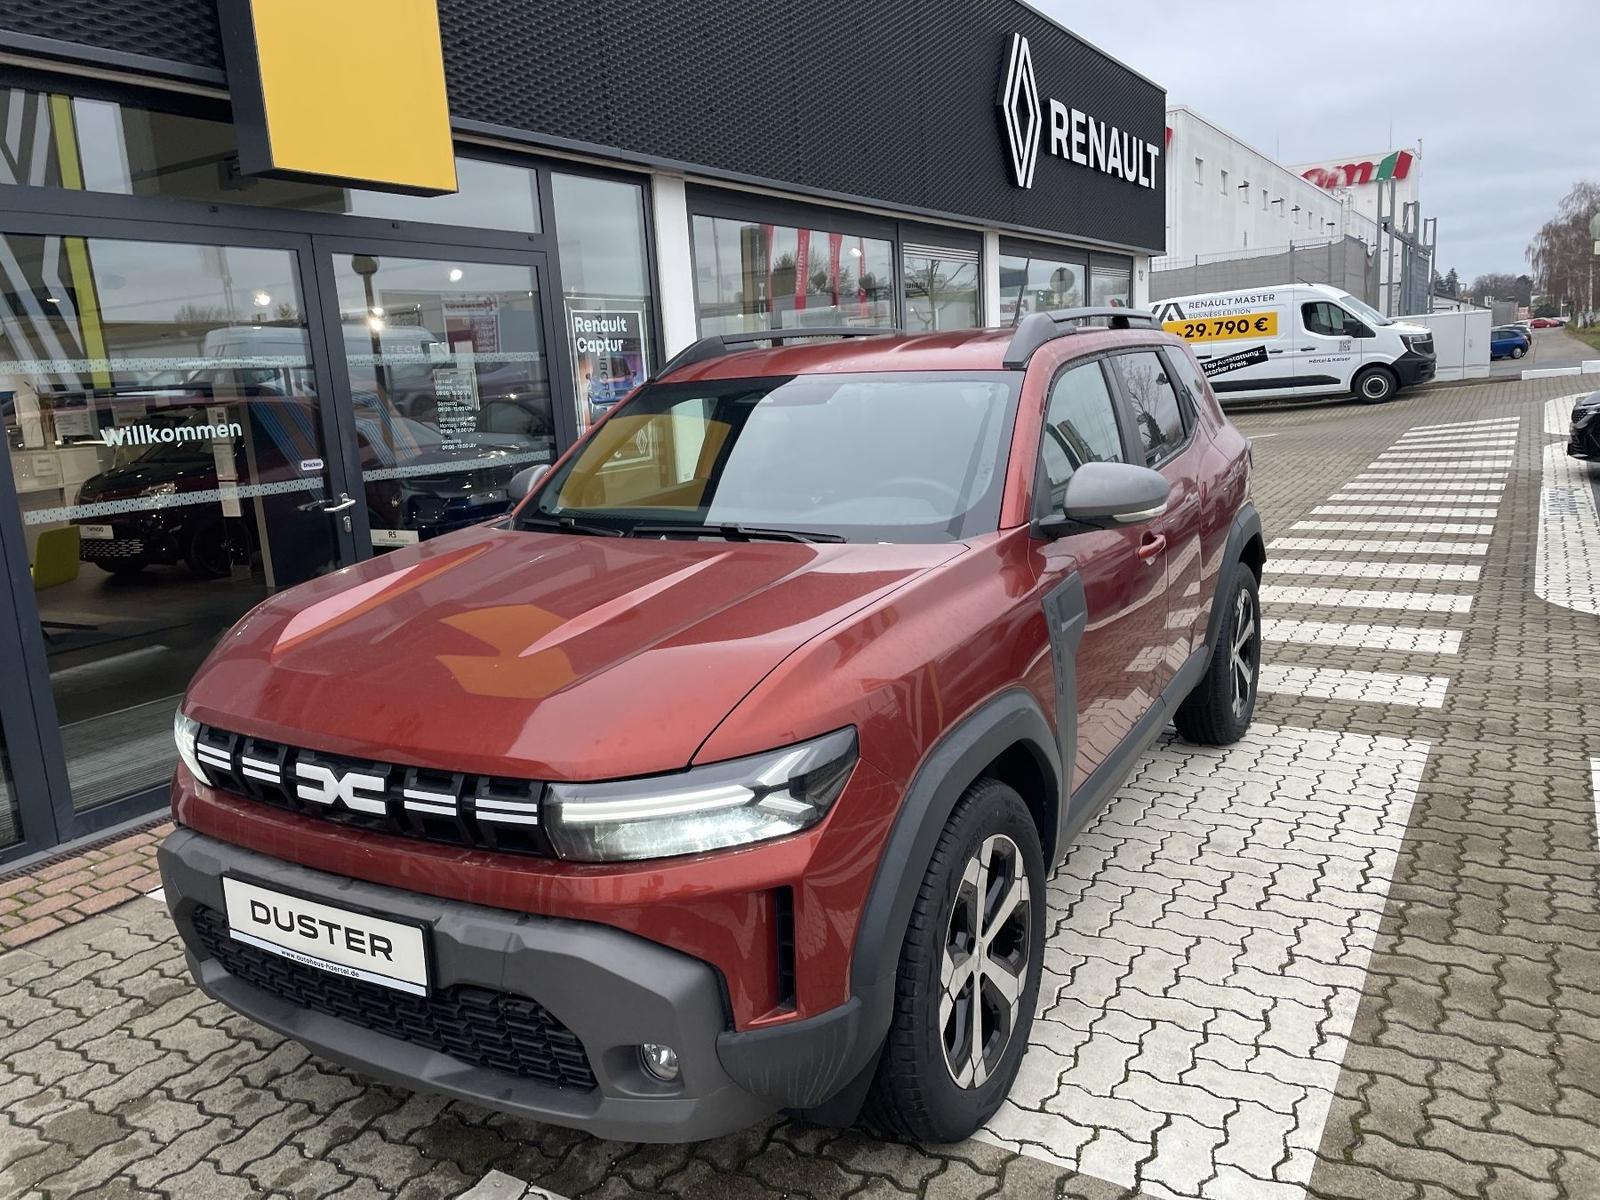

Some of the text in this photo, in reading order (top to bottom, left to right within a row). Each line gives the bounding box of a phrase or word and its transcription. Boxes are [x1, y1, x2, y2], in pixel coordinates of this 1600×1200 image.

[1050, 98, 1159, 189] RENAULT
[1189, 294, 1275, 309] RENAULT MASTER
[1223, 308, 1251, 317] EDITION
[575, 316, 627, 333] Renault
[1184, 319, 1249, 338] 29.790
[1254, 317, 1268, 332] €
[577, 337, 624, 356] Captur
[1203, 362, 1216, 370] Top
[1230, 360, 1248, 369] Preis.
[99, 421, 243, 448] Willkommen
[250, 899, 394, 962] DUSTER
[281, 950, 360, 978] www.autohaus-haertel.de
